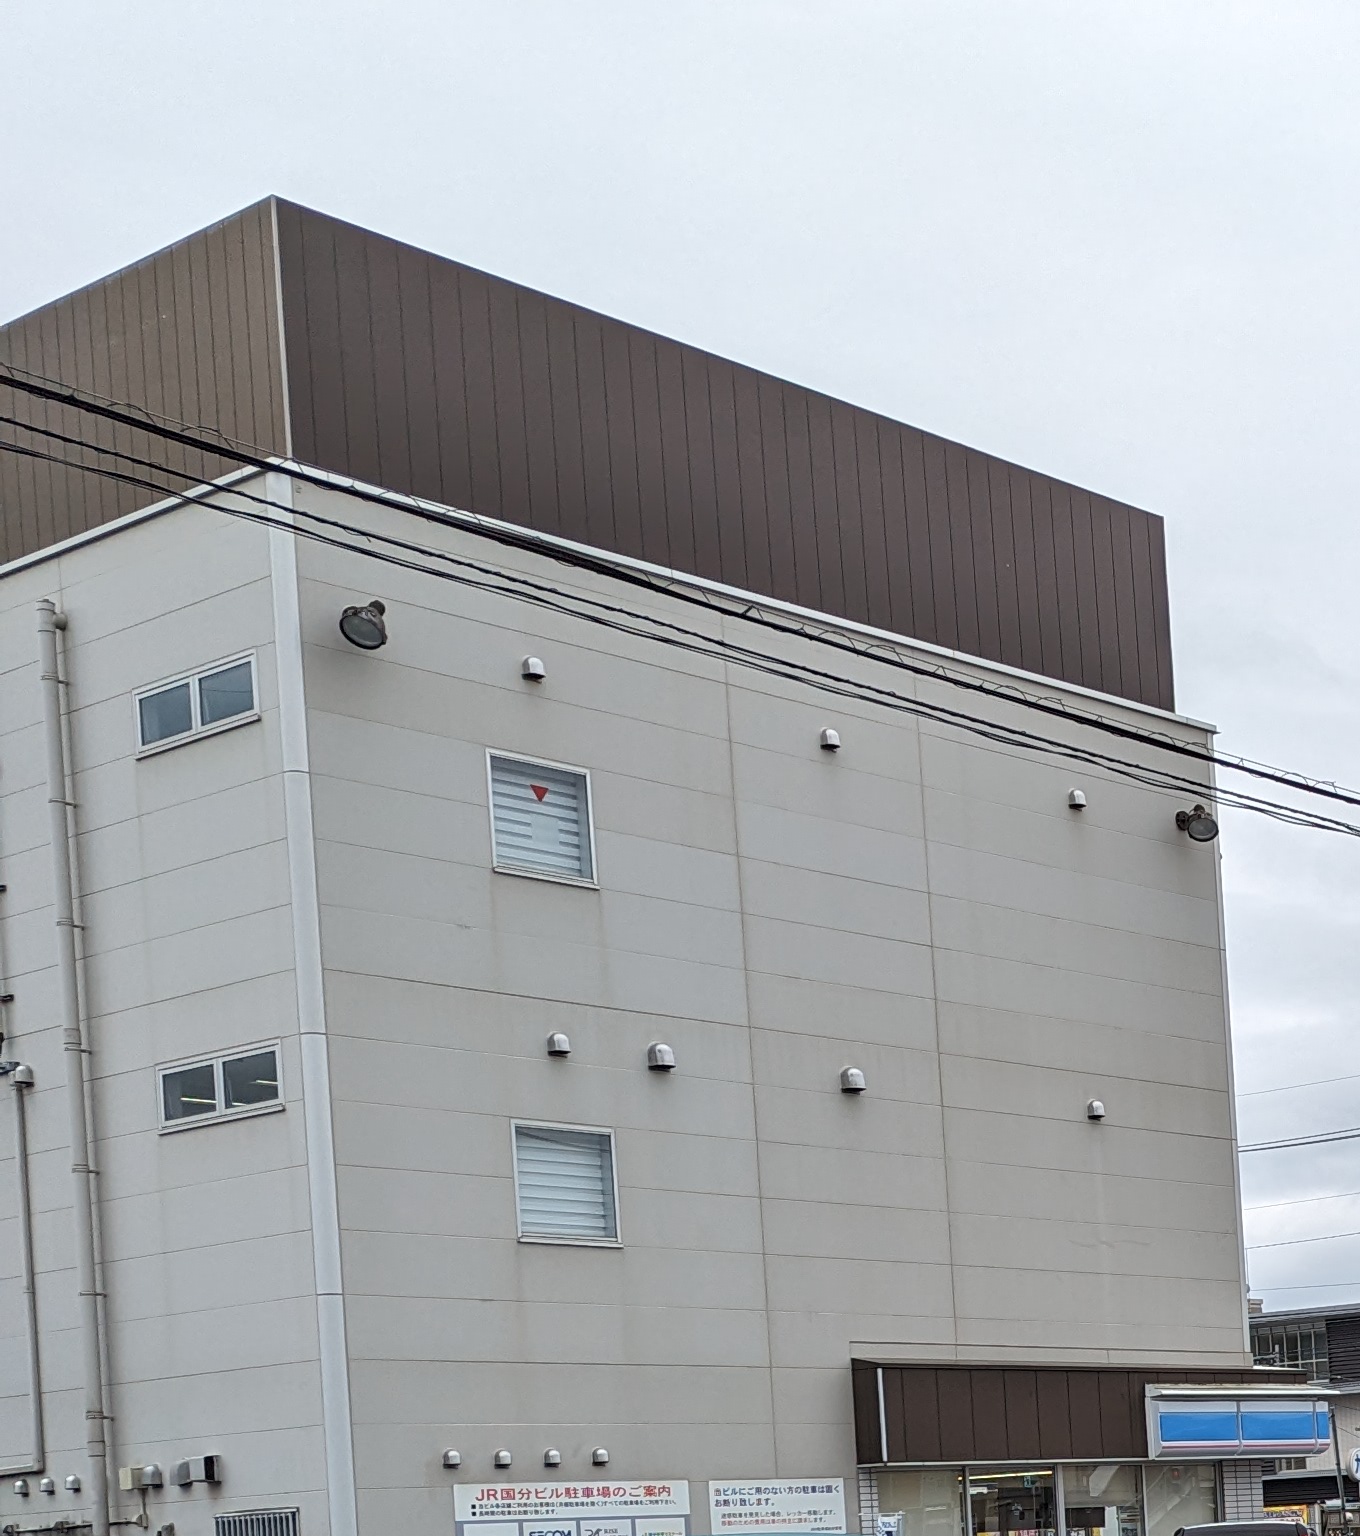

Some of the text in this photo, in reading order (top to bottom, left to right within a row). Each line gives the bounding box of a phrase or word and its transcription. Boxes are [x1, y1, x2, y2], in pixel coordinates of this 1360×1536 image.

[475, 1485, 671, 1502] JR国分ビル駐車場のご案内
